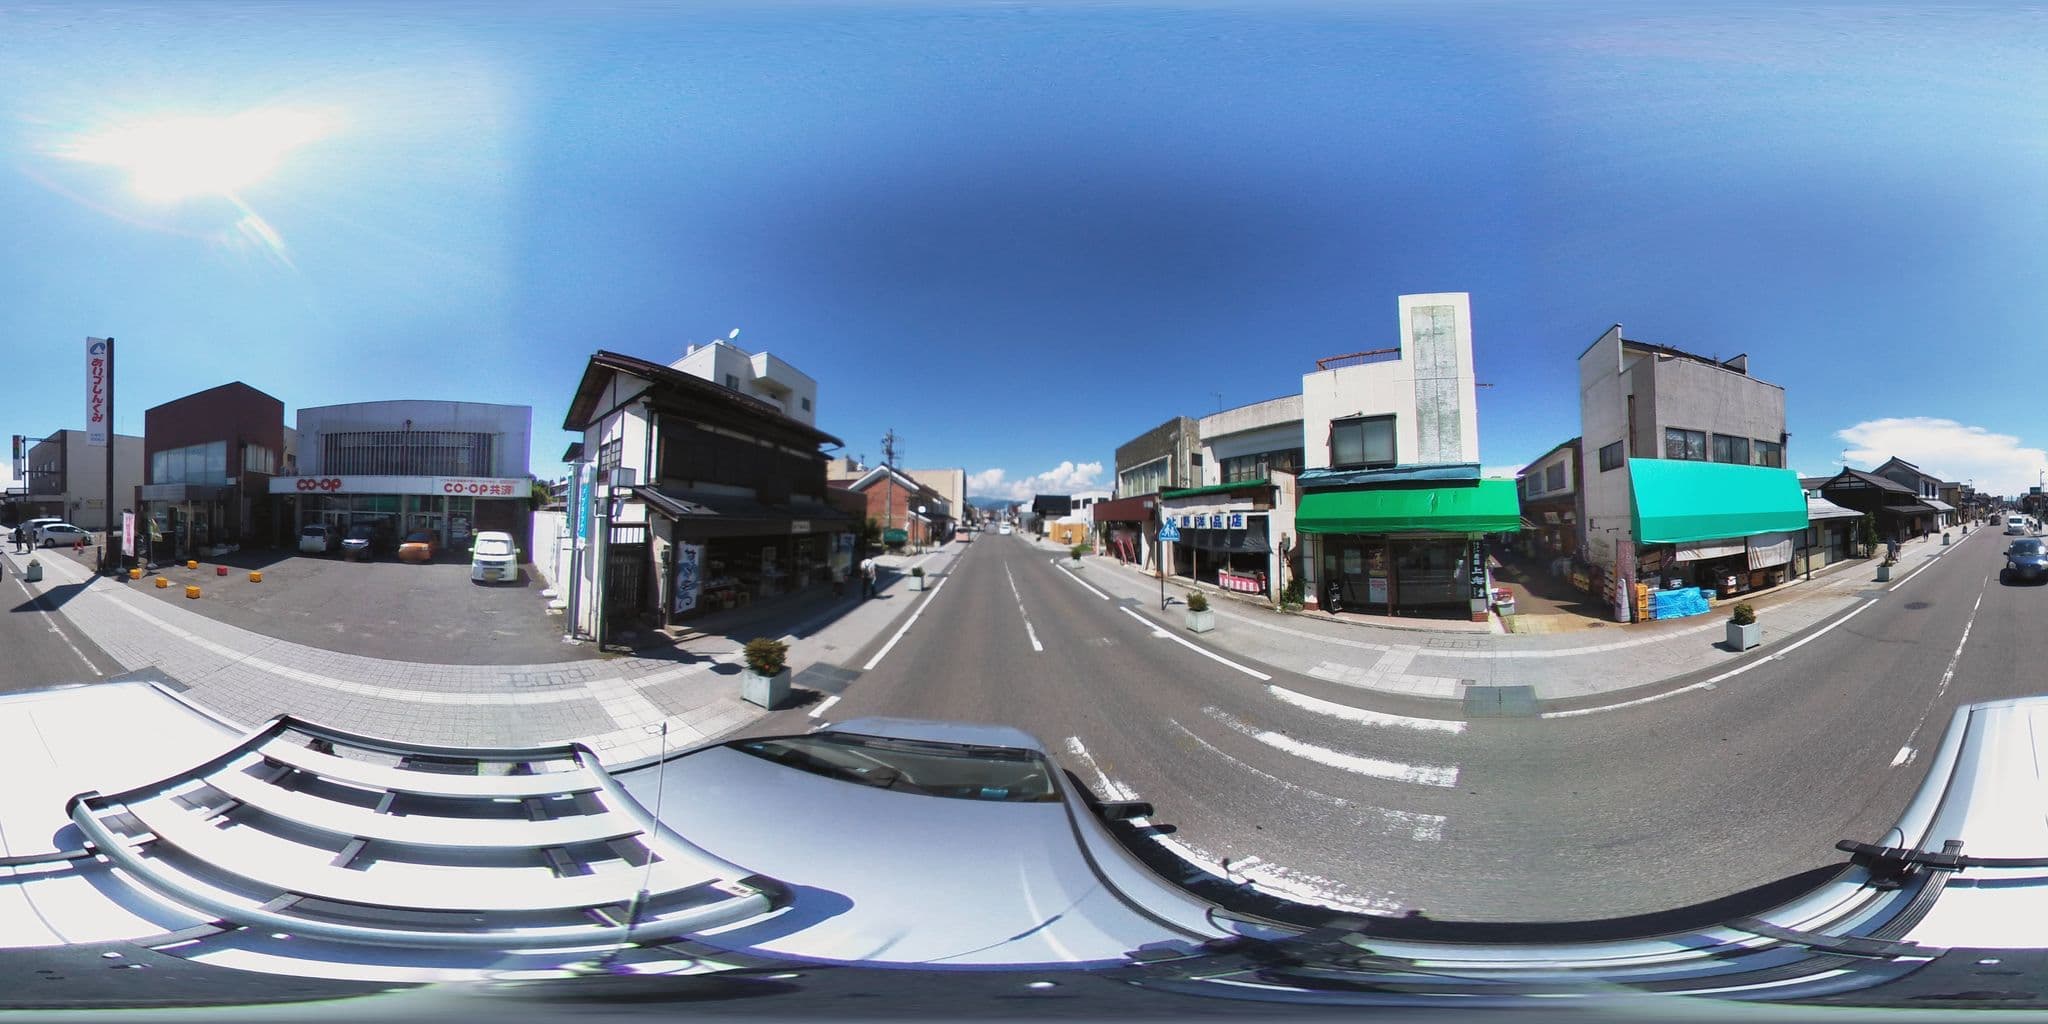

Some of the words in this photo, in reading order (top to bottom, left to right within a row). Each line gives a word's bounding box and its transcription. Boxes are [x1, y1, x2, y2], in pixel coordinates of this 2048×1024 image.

[91, 358, 104, 422] あいづしんくみ
[1166, 513, 1242, 528] 野洋品店
